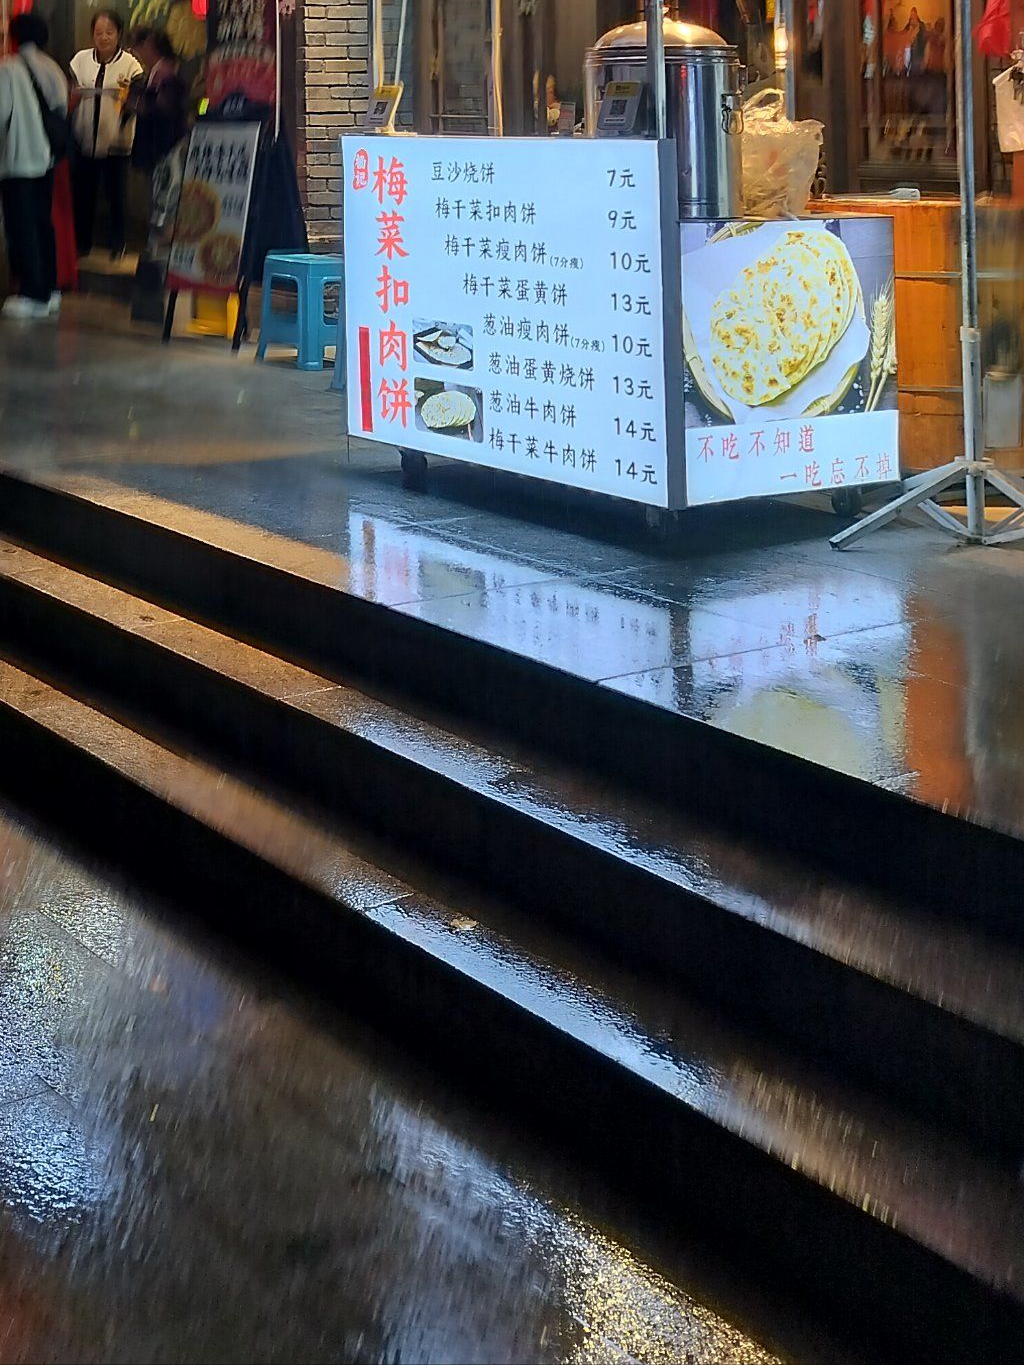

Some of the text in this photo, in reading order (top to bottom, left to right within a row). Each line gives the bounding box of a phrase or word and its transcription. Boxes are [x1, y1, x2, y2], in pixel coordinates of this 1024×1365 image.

[430, 161, 637, 189] 豆沙烧饼 7元
[434, 197, 638, 231] 梅干菜扣肉饼 9元
[609, 251, 652, 274] 10元
[372, 155, 412, 429] 梅菜扣肉饼
[462, 272, 652, 317] 梅干菜蛋黄饼 13元
[611, 334, 653, 358] 10元
[487, 352, 654, 400] 葱油蛋黄烧饼 13元
[487, 389, 657, 443] 葱油牛肉饼 14元
[487, 426, 659, 486] 梅干菜牛肉饼 14元
[696, 424, 816, 463] 不吃不知道
[779, 452, 893, 487] 一吃忘不掉
